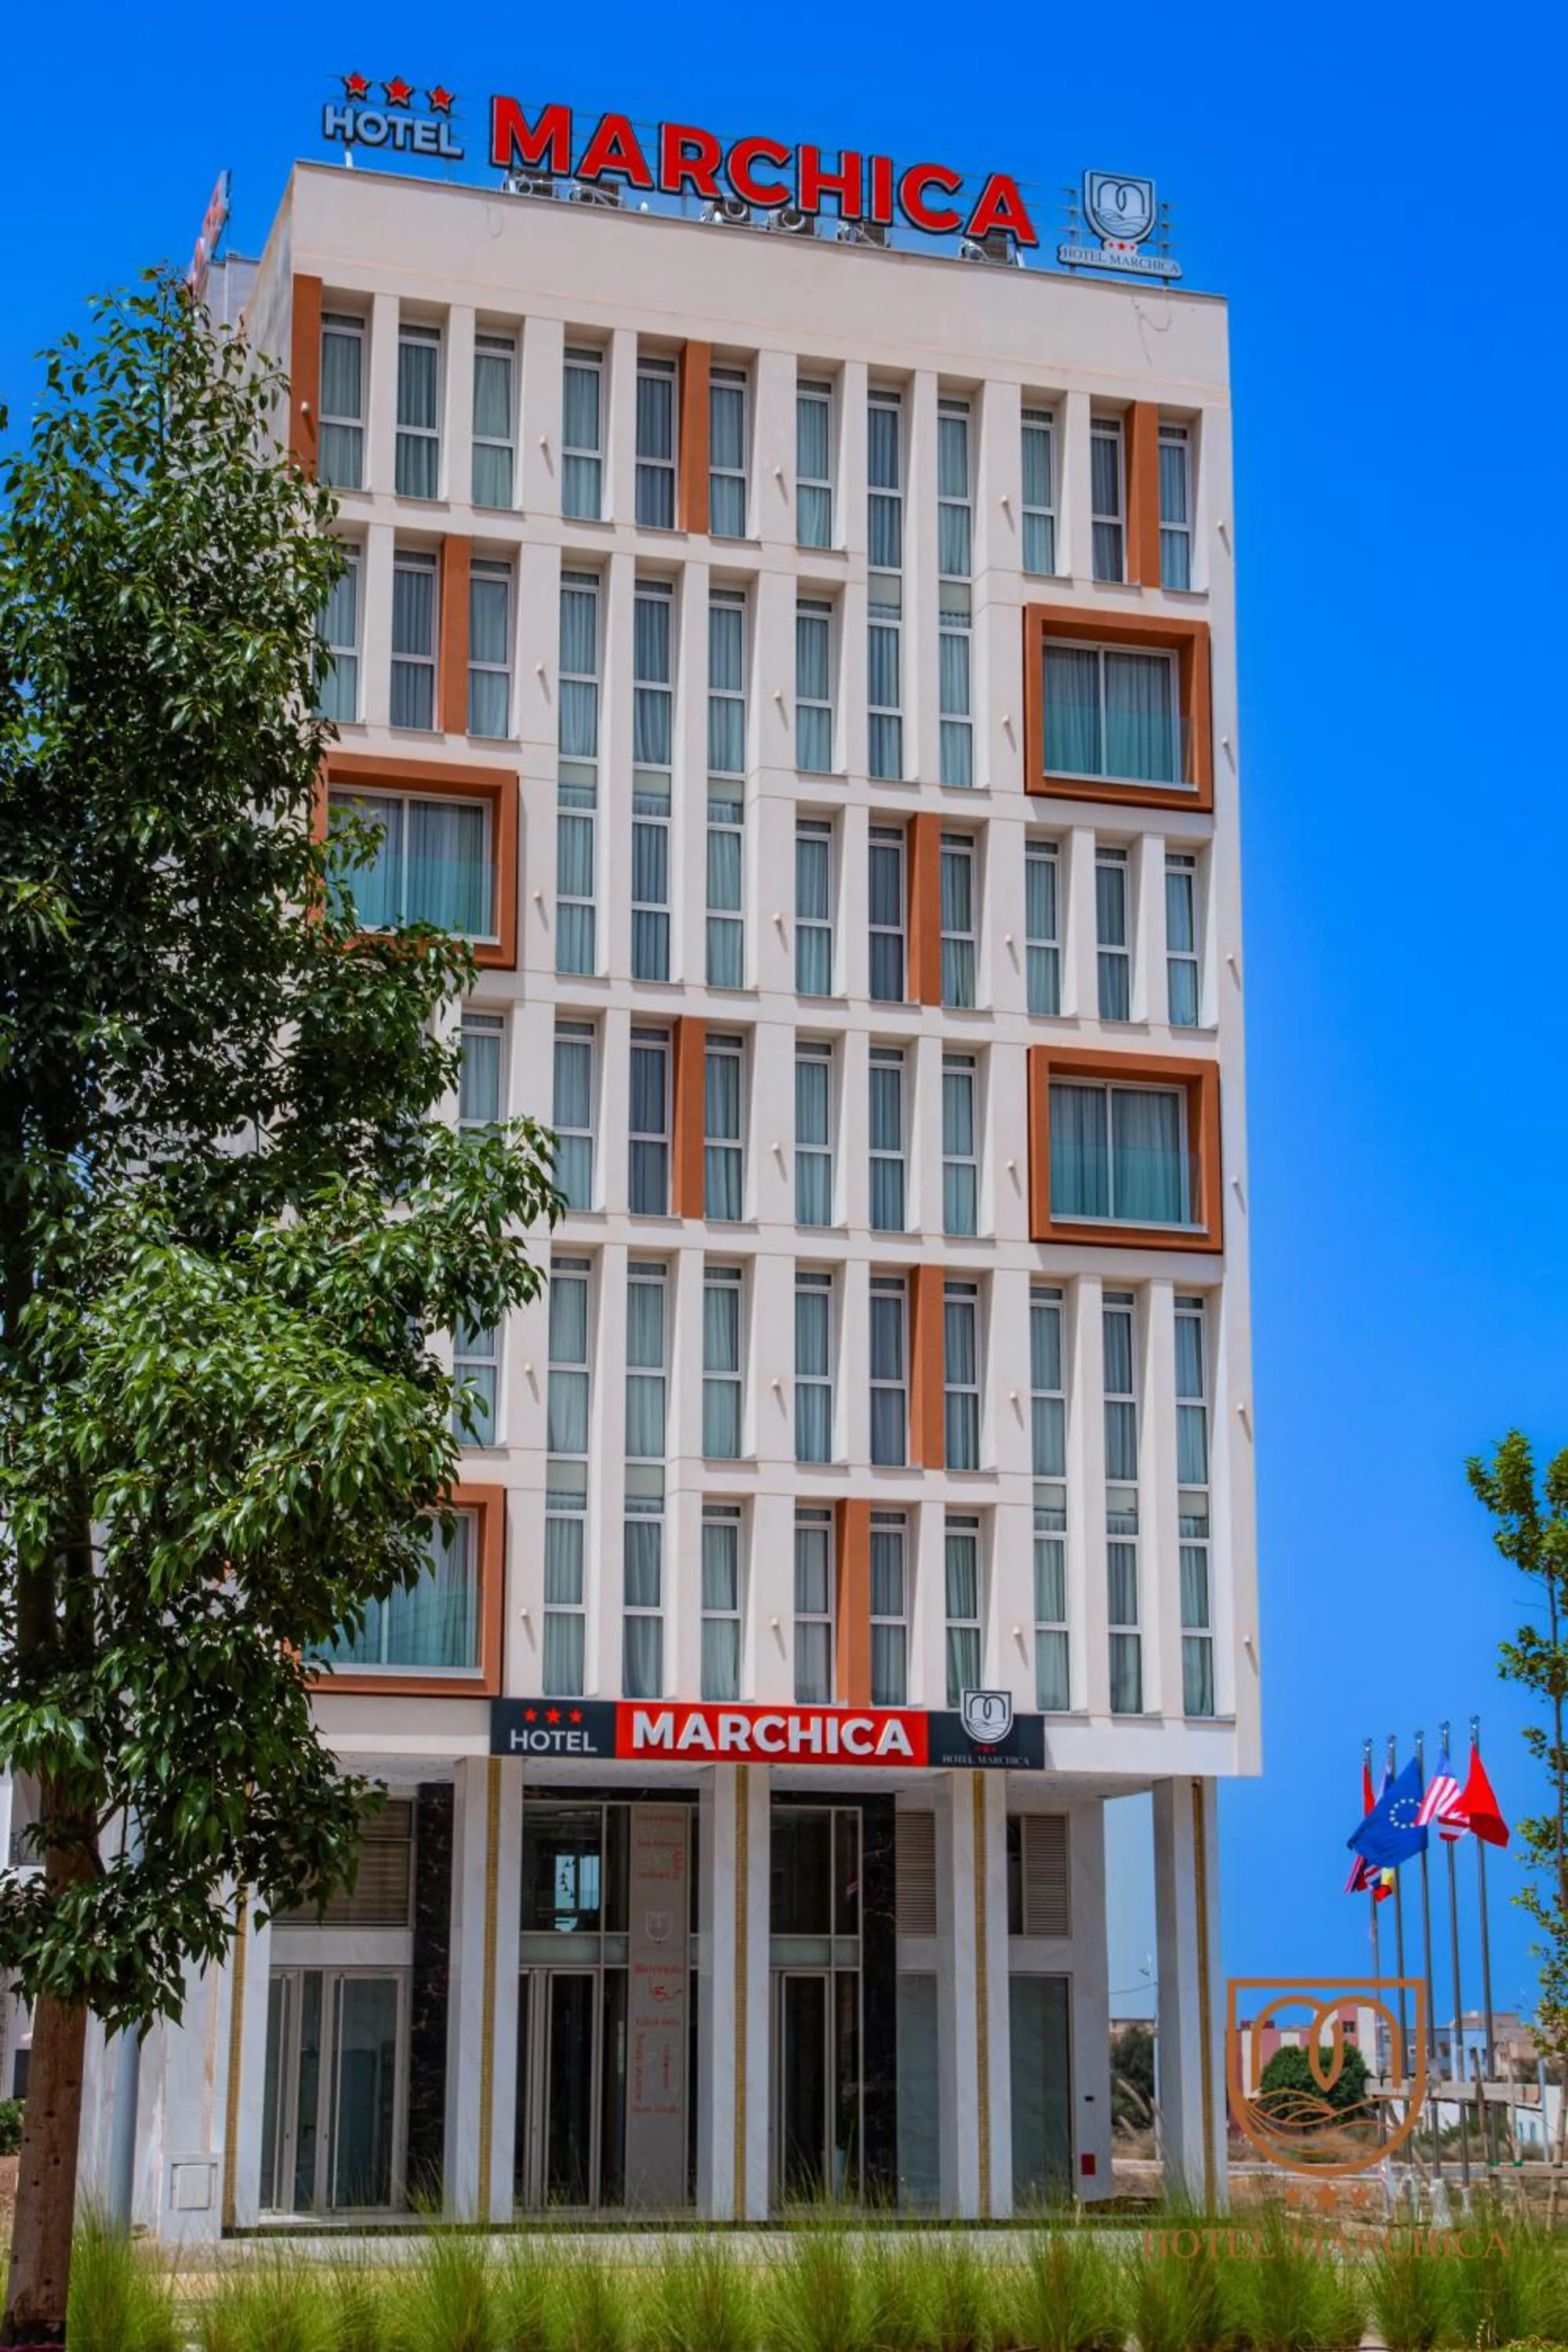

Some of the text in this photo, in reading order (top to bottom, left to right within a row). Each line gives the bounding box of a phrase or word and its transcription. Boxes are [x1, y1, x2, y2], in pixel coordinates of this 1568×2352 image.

[323, 94, 1040, 248] HOTEL MARCHICA
[1062, 246, 1179, 274] HOTEL MARCHICA
[509, 1711, 913, 1756] HOTEL MARCHICA
[942, 1754, 974, 1764] HOTEL
